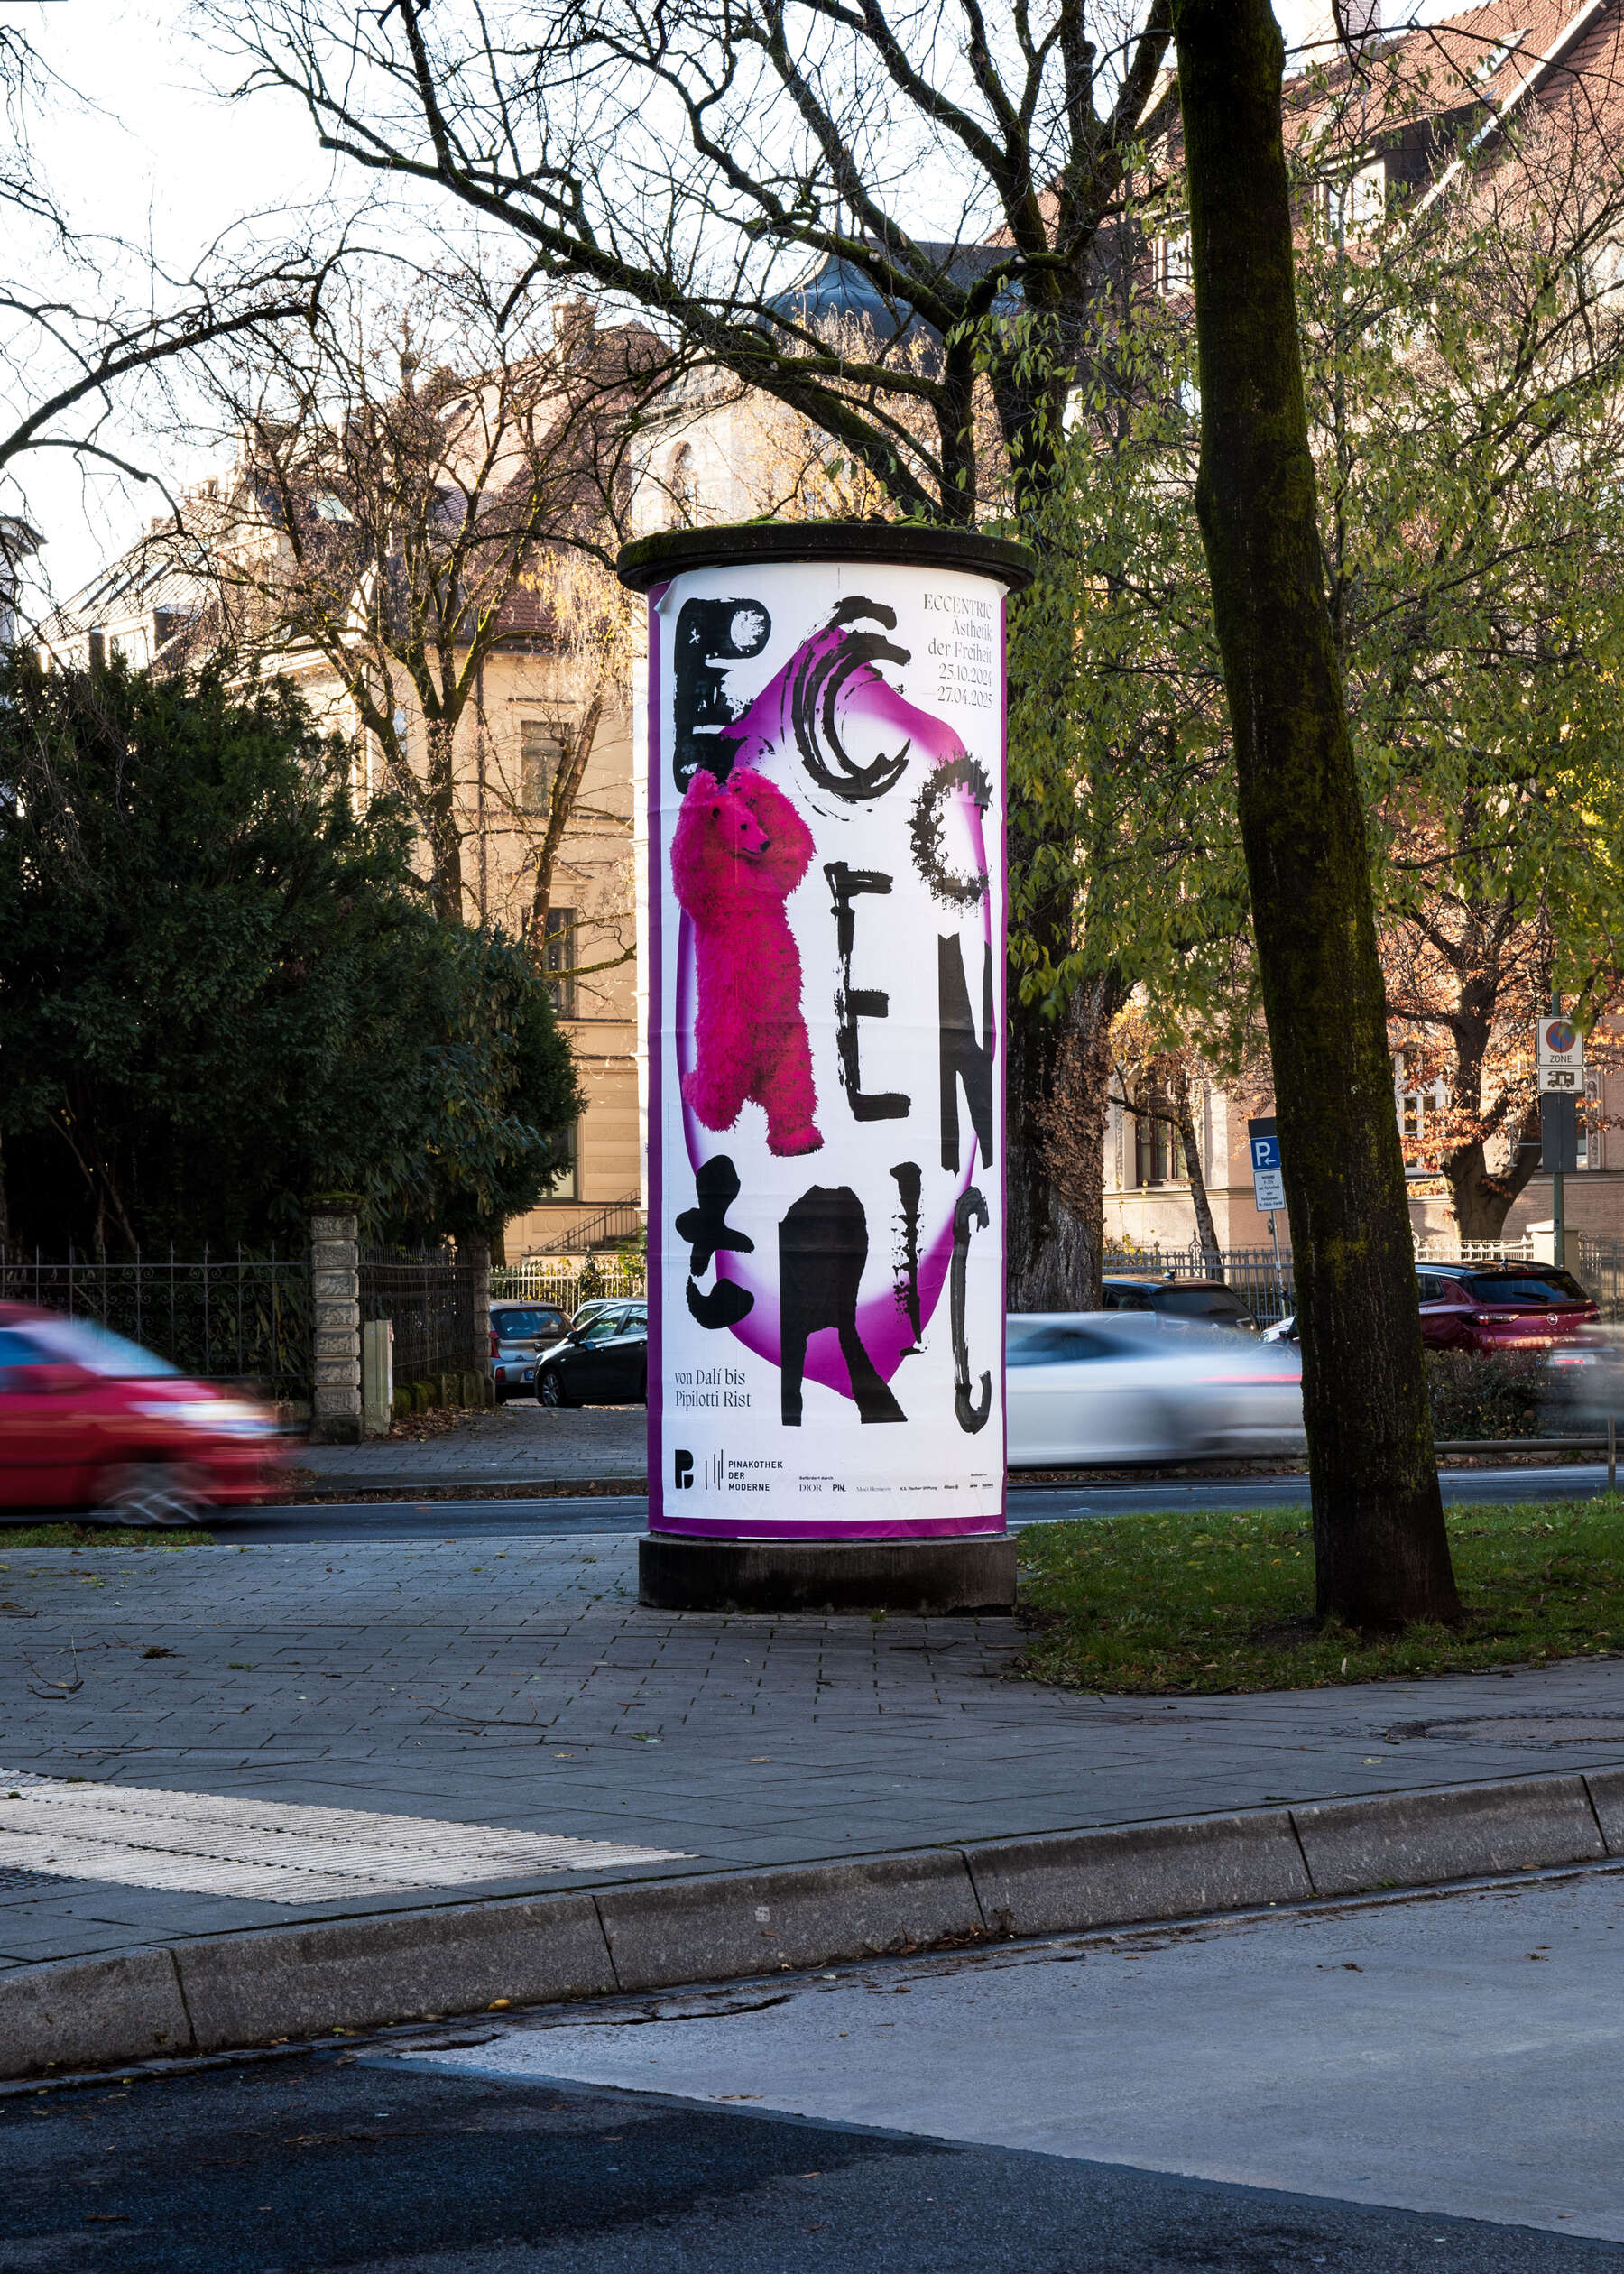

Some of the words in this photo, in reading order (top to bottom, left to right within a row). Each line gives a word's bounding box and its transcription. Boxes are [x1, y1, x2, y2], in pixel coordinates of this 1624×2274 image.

[923, 594, 992, 620] ECCENTRIC
[952, 615, 992, 642] Ästhetik
[928, 638, 951, 657] der
[955, 642, 992, 664] Freiheit
[938, 663, 992, 687] 25.10.2024
[1549, 1054, 1573, 1063] ZONE
[1255, 1142, 1271, 1167] P
[675, 1372, 692, 1385] von
[696, 1368, 722, 1385] Dalí
[724, 1368, 746, 1385] bis
[676, 1390, 719, 1411] Pipilotti
[724, 1391, 751, 1408] Rist
[728, 1460, 783, 1468] PINAKOTHEK
[728, 1472, 745, 1480] DER
[728, 1483, 770, 1492] MODERNE
[799, 1484, 822, 1492] DIOR
